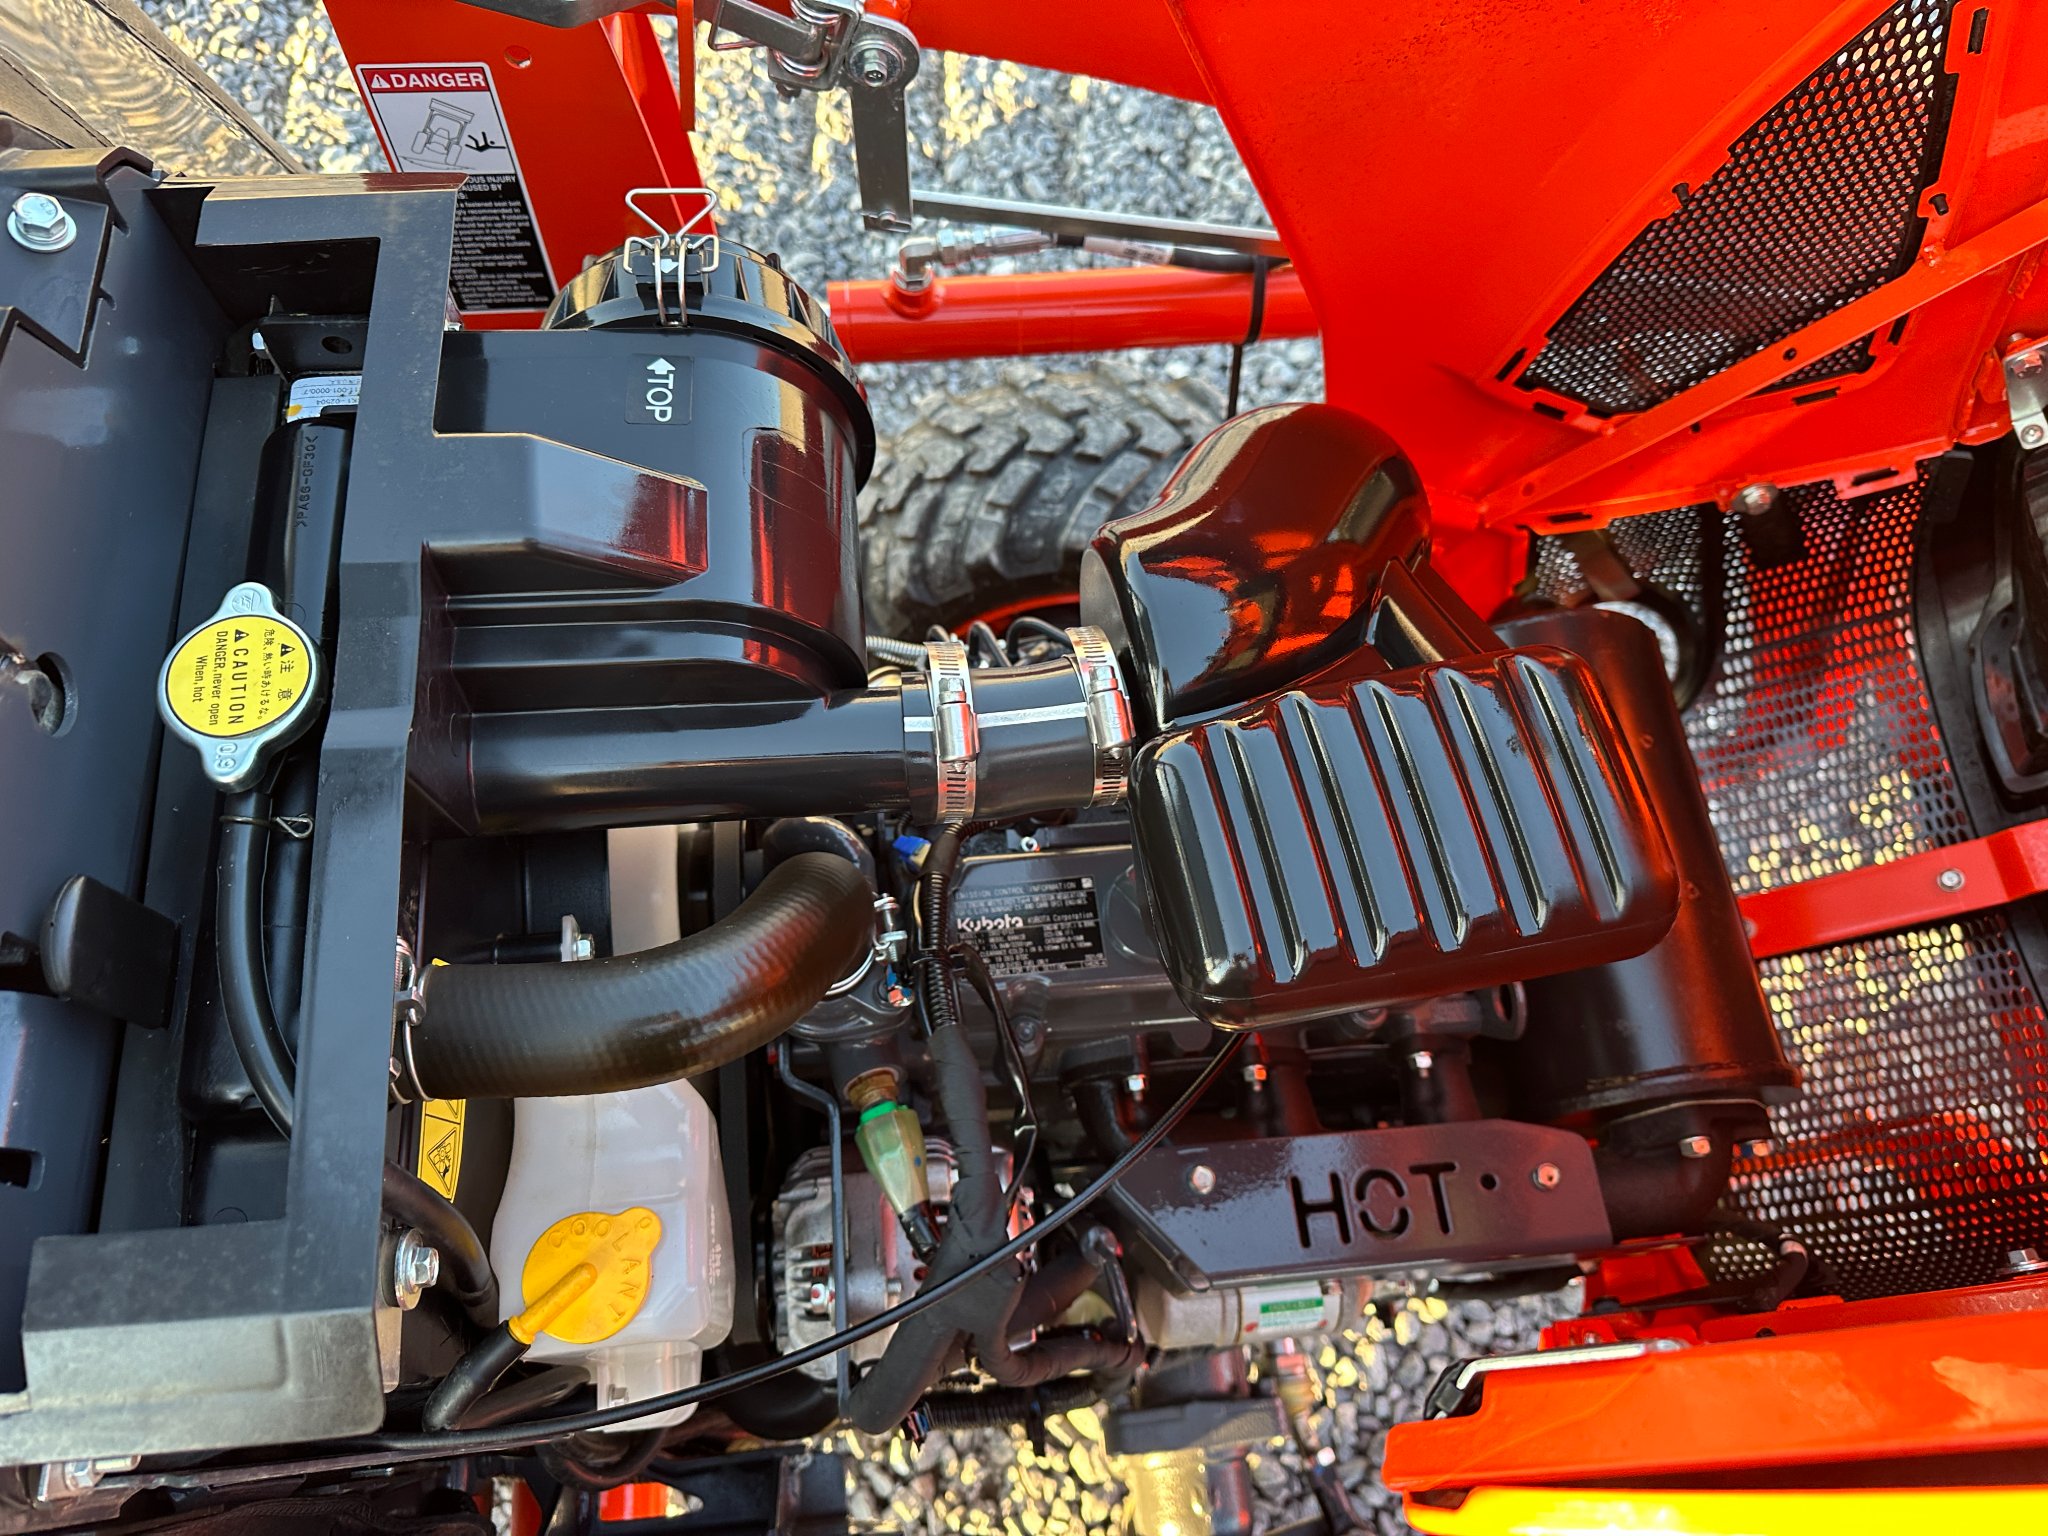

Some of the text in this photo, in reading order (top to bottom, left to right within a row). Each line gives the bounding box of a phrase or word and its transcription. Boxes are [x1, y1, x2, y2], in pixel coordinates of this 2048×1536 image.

[390, 72, 486, 89] DANGER
[487, 175, 516, 183] INJURY
[645, 373, 674, 422] TOP
[228, 648, 249, 725] CAUTION
[208, 703, 220, 726] open
[957, 914, 1023, 932] Kubota
[1289, 1161, 1459, 1249] HOT
